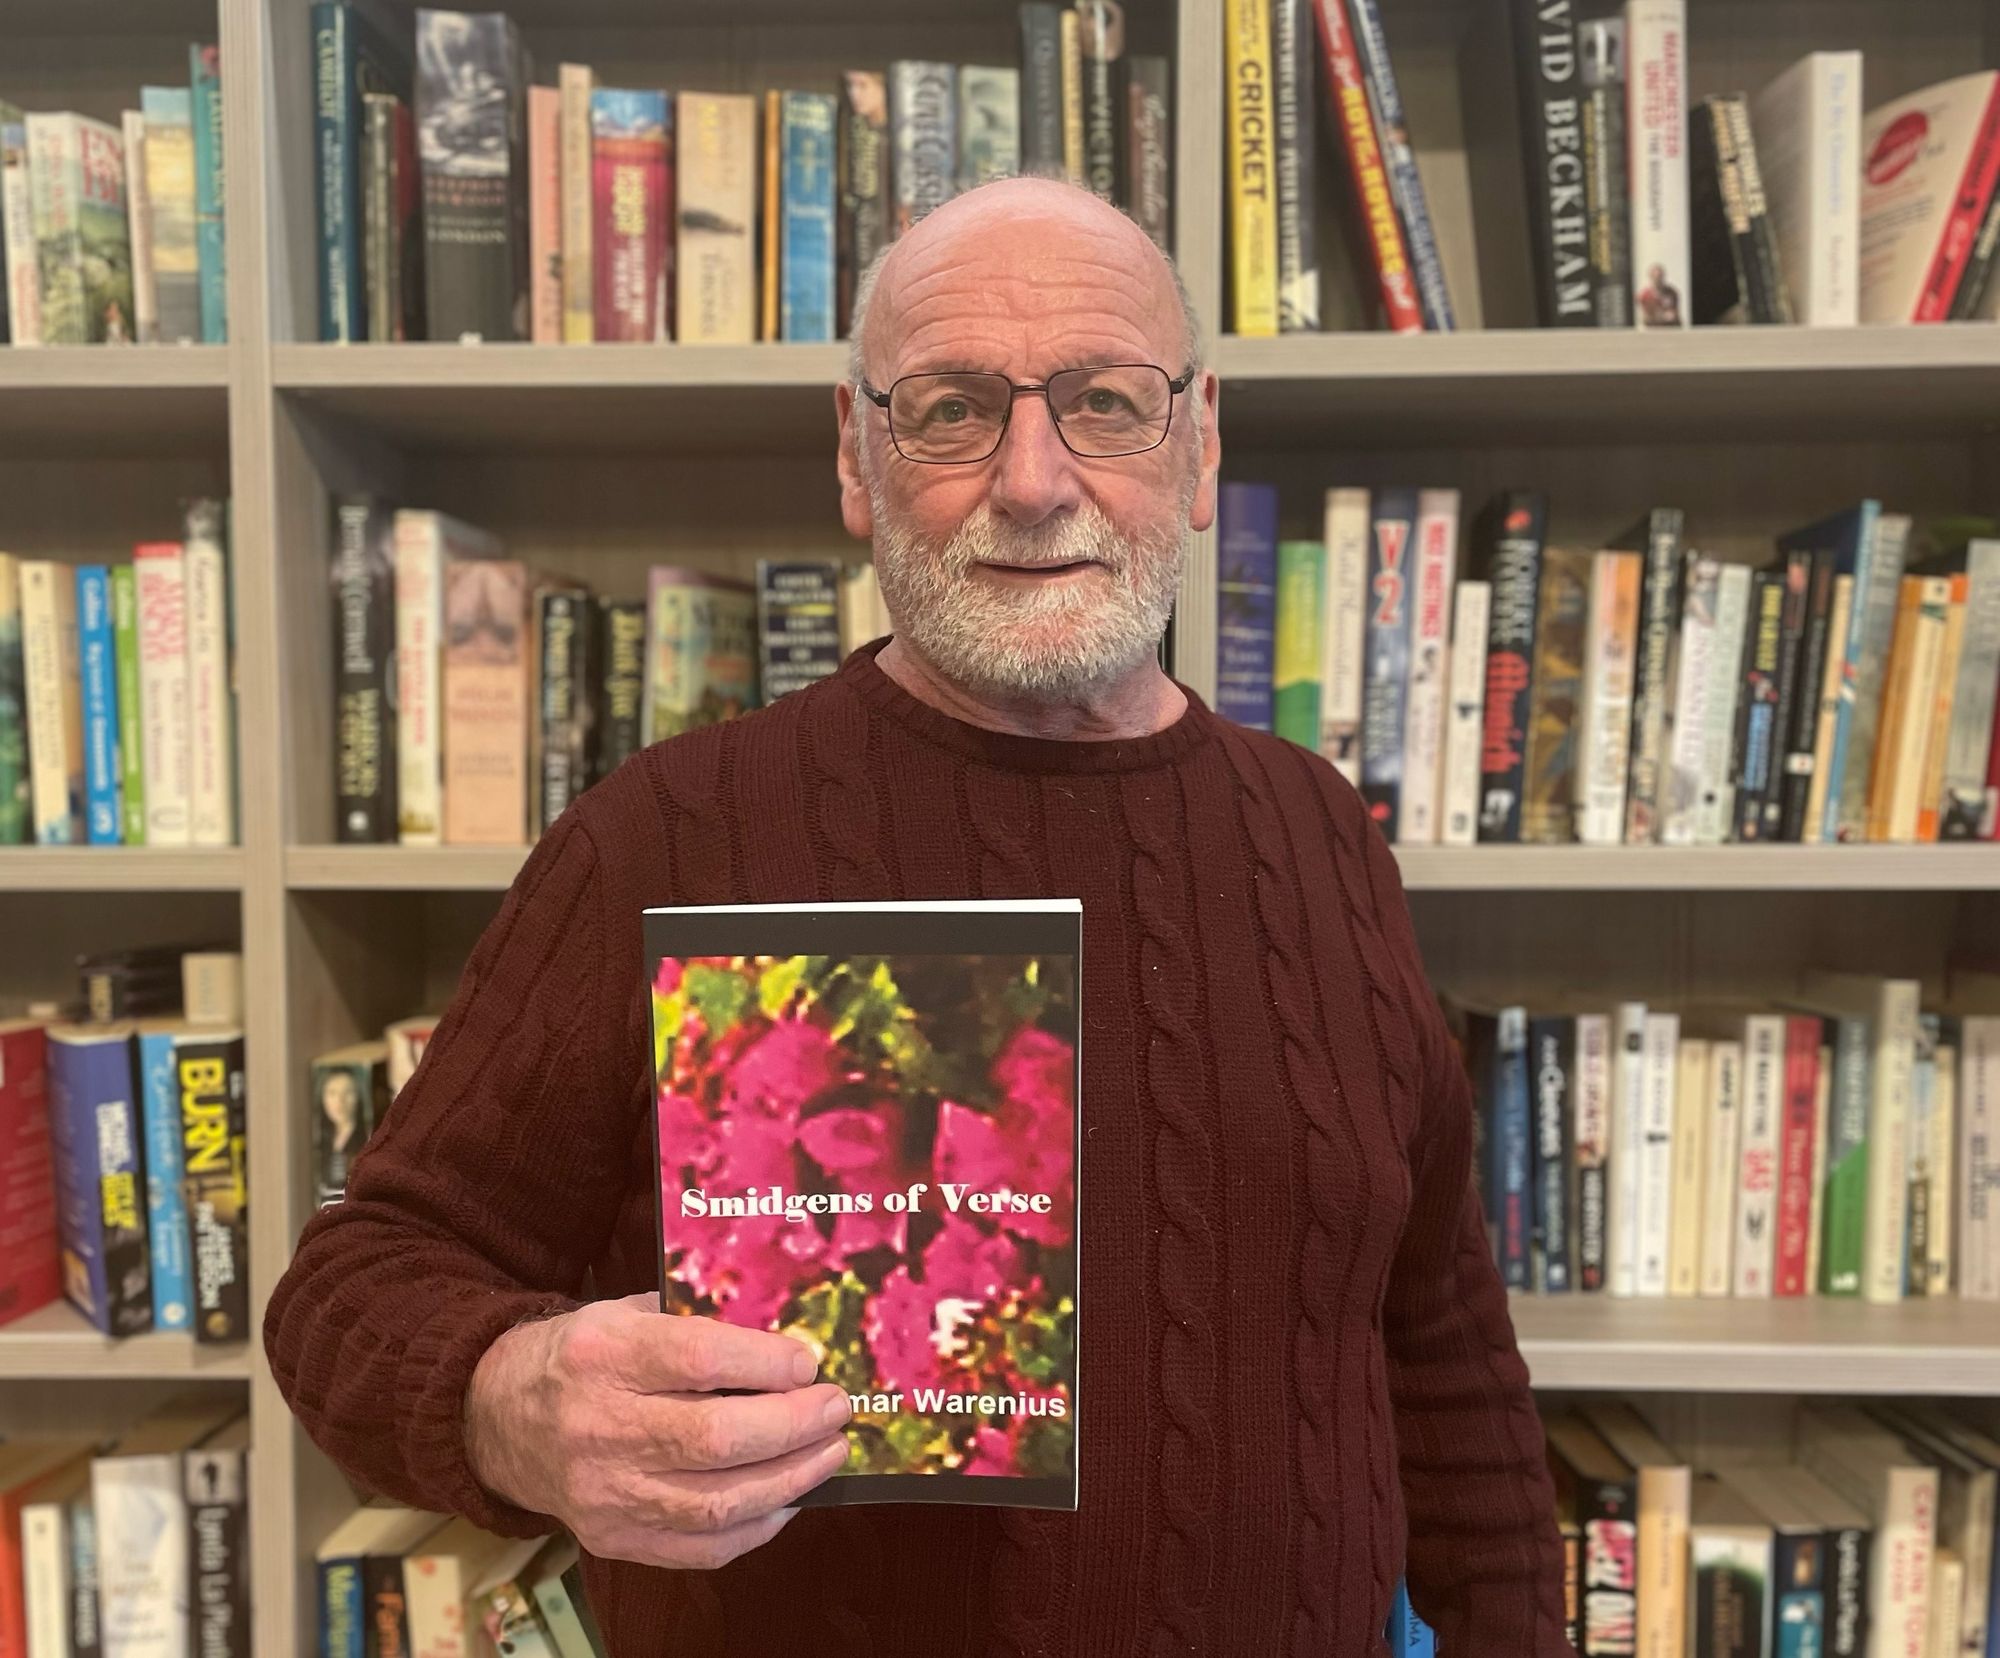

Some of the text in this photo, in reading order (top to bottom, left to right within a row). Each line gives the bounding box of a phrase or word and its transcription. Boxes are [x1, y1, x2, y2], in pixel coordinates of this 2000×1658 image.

[1237, 60, 1267, 201] CRICKET
[1642, 61, 1663, 130] UNITED
[1661, 30, 1681, 159] MANCHESTER
[428, 229, 507, 243] LONDON
[1360, 168, 1405, 275] ROVERS
[1544, 98, 1592, 315] BECKHAM
[82, 577, 105, 632] Collins
[1372, 519, 1410, 626] V 2
[1481, 651, 1530, 773] Munich
[180, 1056, 229, 1173] BURN
[194, 1201, 223, 1309] PATTERSON
[681, 1183, 1053, 1223] Smidgens of Verse
[848, 1388, 1067, 1417] mar Warenius
[1408, 1604, 1421, 1648] MMA
